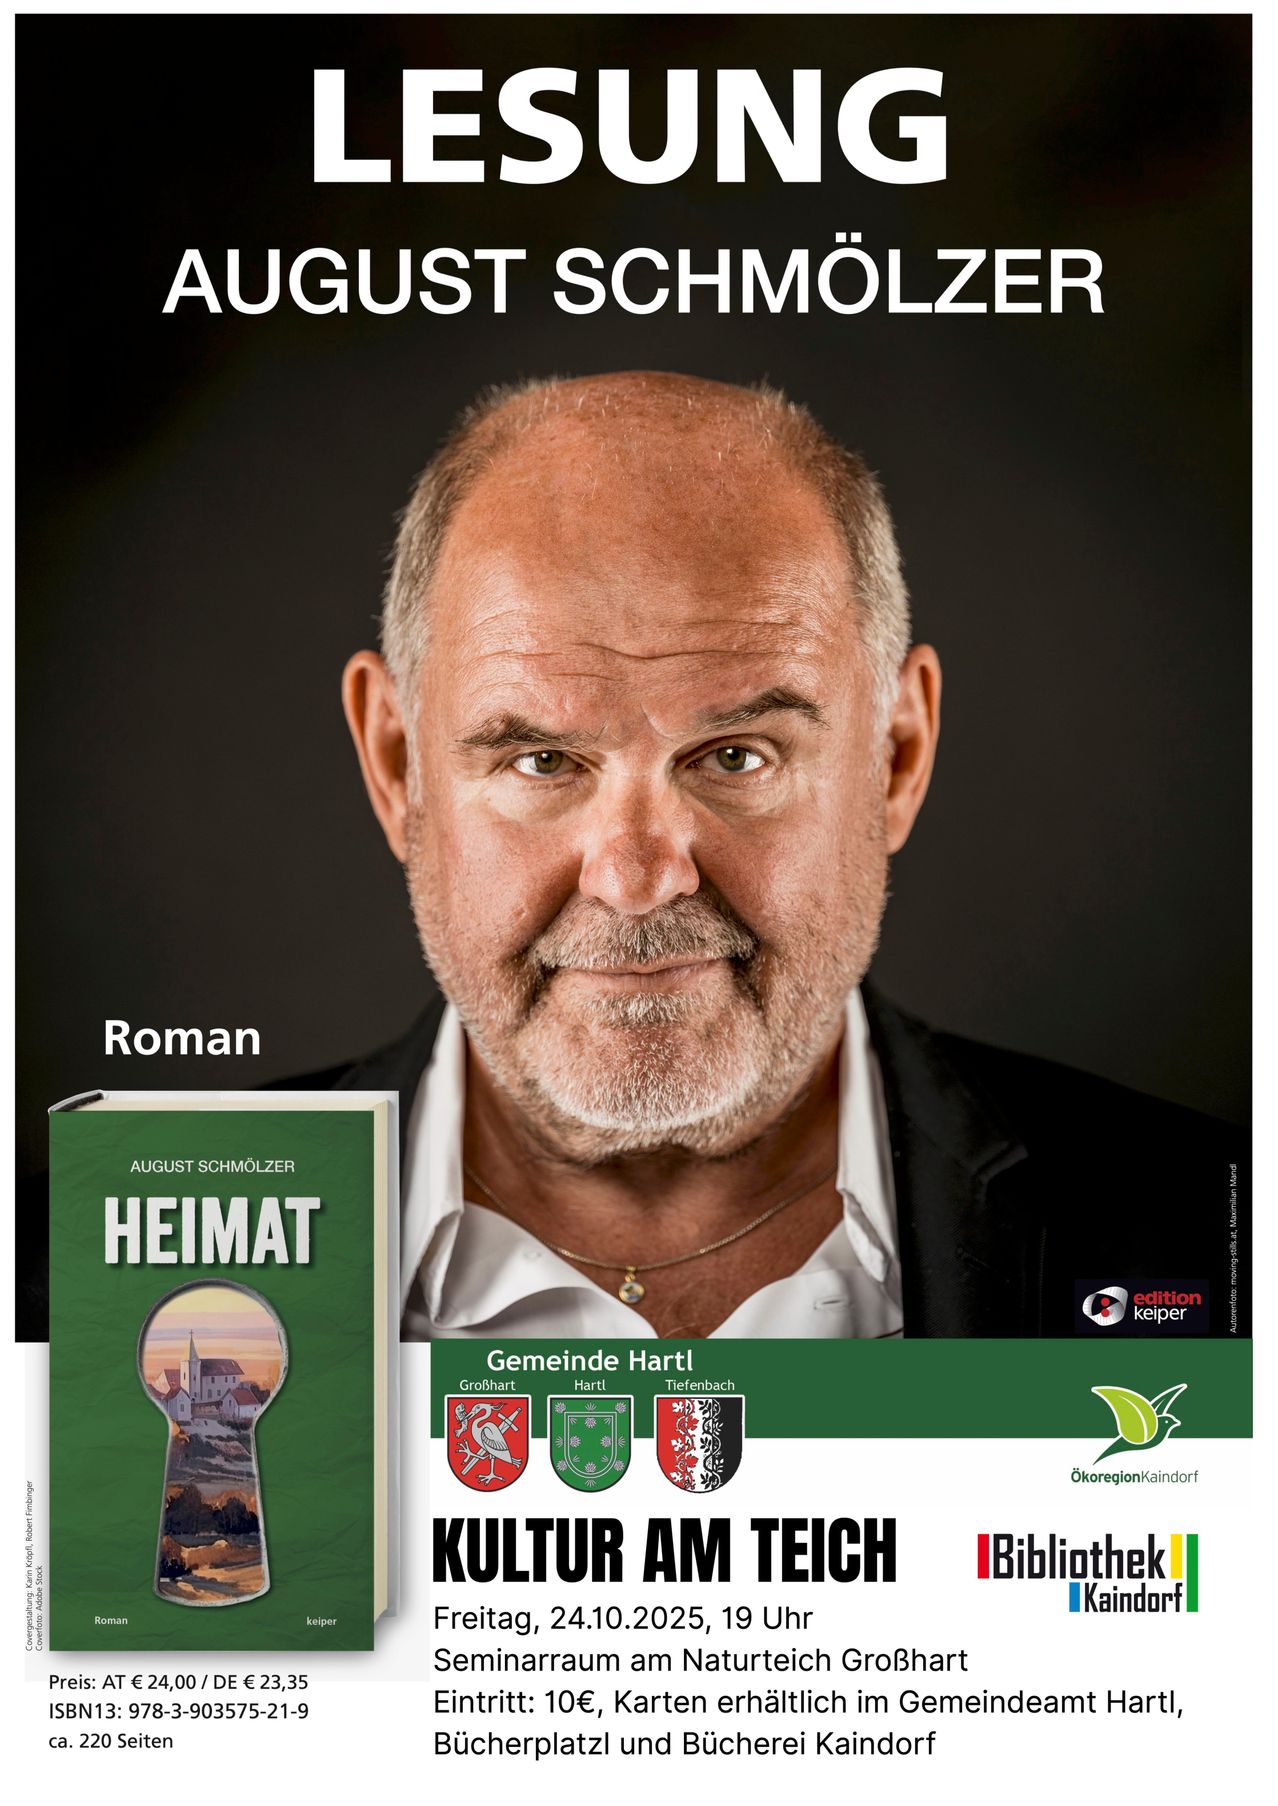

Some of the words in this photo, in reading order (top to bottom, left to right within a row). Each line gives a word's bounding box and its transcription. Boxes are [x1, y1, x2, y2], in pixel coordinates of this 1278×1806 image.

[313, 67, 947, 185] LESUNG
[162, 247, 527, 315] AUGUST
[553, 231, 1105, 315] SCHMÖLZER
[105, 1019, 260, 1056] Roman
[130, 1159, 194, 1173] AUGUST
[198, 1157, 295, 1173] SCHMÖLZER
[1229, 1163, 1238, 1187] Mandl
[1229, 1188, 1238, 1228] Maximilian
[104, 1196, 321, 1265] HEIMAT
[1229, 1229, 1239, 1286] moving-stills.at,
[1133, 1290, 1202, 1305] edition
[1134, 1305, 1188, 1325] keiper
[1229, 1287, 1238, 1334] Autorenfoto:
[486, 1349, 620, 1372] Gemeinde
[629, 1348, 694, 1372] Hartl
[459, 1378, 517, 1391] Großhart
[574, 1378, 607, 1391] Hartl
[664, 1378, 735, 1391] Tiefenbach
[25, 1480, 35, 1516] Fimbinger
[25, 1517, 33, 1542] Robert
[25, 1543, 35, 1568] Kröpfl,
[432, 1517, 624, 1584] KULTUR
[642, 1517, 731, 1583] AM
[750, 1517, 897, 1584] TEICH
[993, 1533, 1166, 1579] Bibliothek
[25, 1569, 33, 1589] Karin
[35, 1565, 43, 1586] Stock
[35, 1587, 43, 1612] Adobe
[1084, 1582, 1183, 1613] Kaindorf
[25, 1590, 35, 1652] Covergestaltung:
[35, 1612, 43, 1652] Coverfoto:
[94, 1615, 128, 1626] Roman
[306, 1616, 337, 1627] keiper
[434, 1605, 540, 1636] Freitag,
[550, 1605, 711, 1635] 24.10.2025,
[722, 1605, 753, 1630] 19
[763, 1605, 814, 1630] Uhr
[433, 1647, 620, 1672] Seminarraum
[630, 1653, 672, 1672] am
[683, 1647, 831, 1672] Naturteich
[841, 1647, 969, 1672] Großhart
[49, 1674, 96, 1690] Preis:
[101, 1674, 127, 1690] AT
[130, 1674, 143, 1690] €
[147, 1674, 197, 1693] 24,00
[200, 1674, 209, 1690] /
[213, 1674, 238, 1690] DE
[242, 1674, 256, 1690] €
[259, 1674, 309, 1693] 23,35
[49, 1702, 122, 1720] ISBN13:
[128, 1702, 309, 1720] 978-3-903575-21-9
[434, 1689, 535, 1714] Eintritt:
[544, 1689, 603, 1719] 10€,
[614, 1689, 707, 1714] Karten
[717, 1689, 847, 1714] erhältlich
[857, 1689, 889, 1714] im
[899, 1689, 1097, 1714] Gemeindeamt
[1107, 1689, 1183, 1719] Hartl,
[48, 1736, 73, 1749] ca.
[79, 1733, 112, 1749] 220
[117, 1733, 173, 1749] Seiten
[434, 1730, 609, 1762] Bücherplatzl
[620, 1731, 671, 1756] und
[683, 1730, 806, 1756] Bücherei
[816, 1730, 937, 1756] Kaindorf
